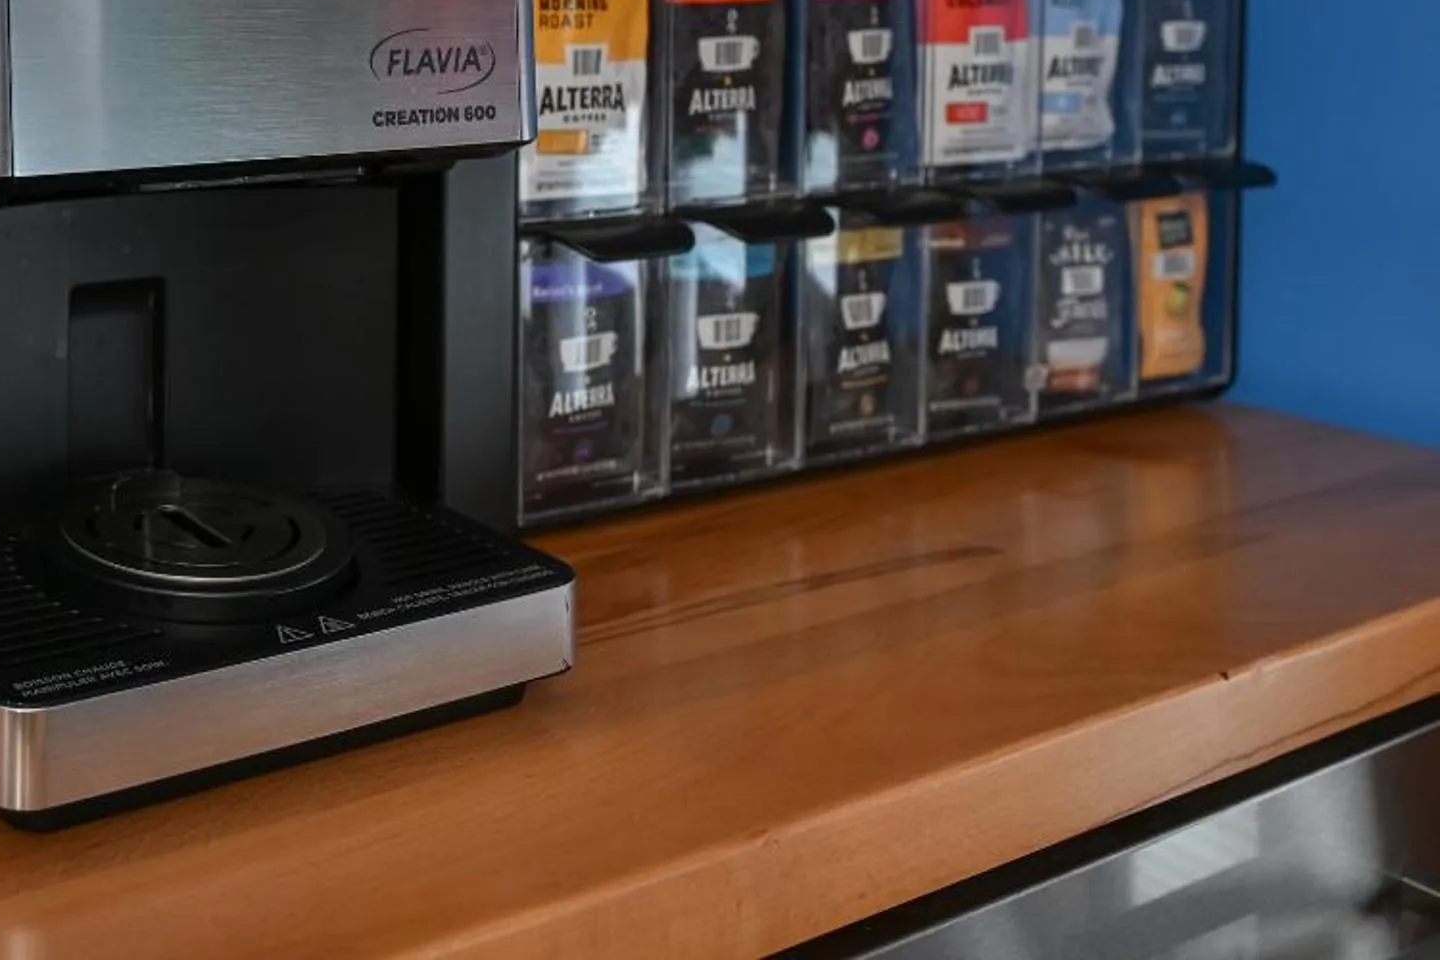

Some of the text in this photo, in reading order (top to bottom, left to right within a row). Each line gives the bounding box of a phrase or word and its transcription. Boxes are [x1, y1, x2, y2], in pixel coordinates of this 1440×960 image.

[539, 13, 594, 30] ROAST
[387, 45, 482, 77] FLAVIA
[540, 81, 626, 116] ALTERRA
[372, 105, 496, 127] CREATION 600
